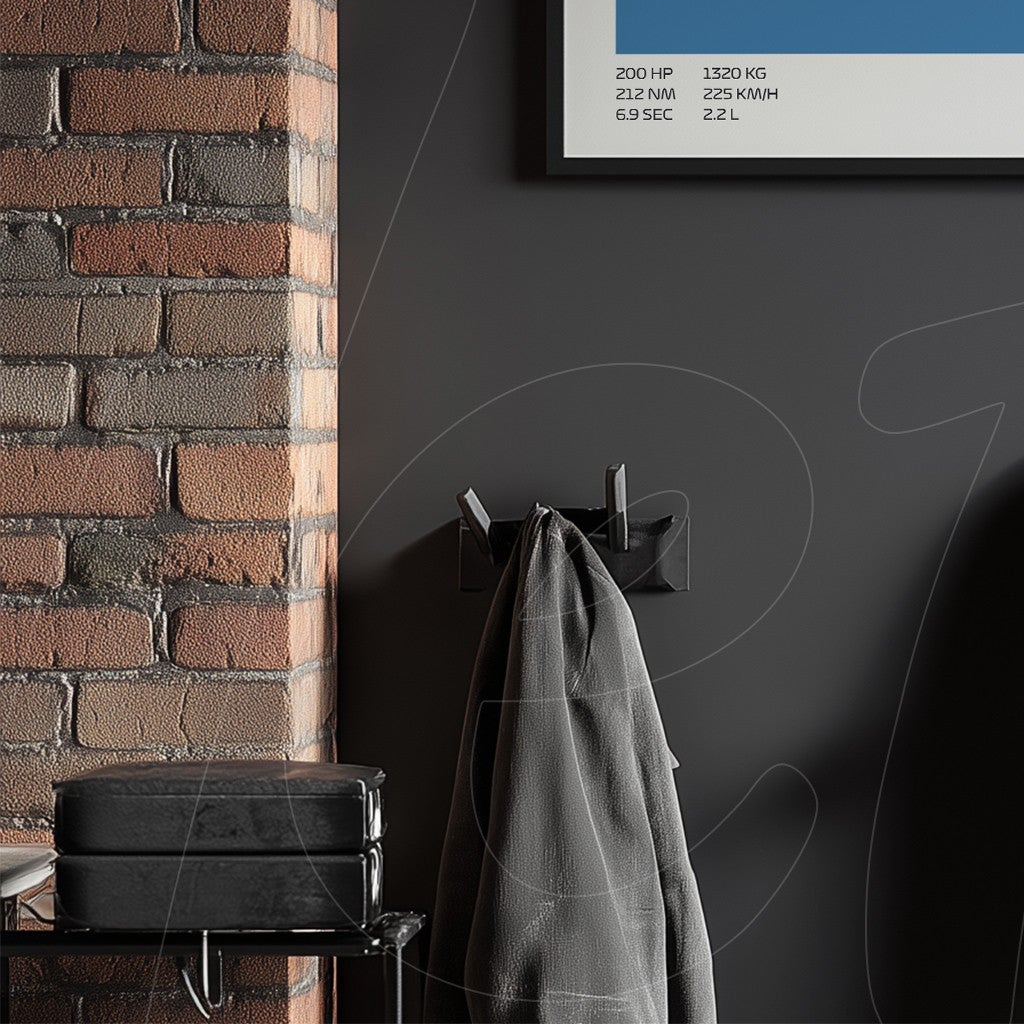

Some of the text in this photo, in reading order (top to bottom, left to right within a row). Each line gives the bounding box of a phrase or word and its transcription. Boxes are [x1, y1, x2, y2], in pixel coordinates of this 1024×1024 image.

[615, 67, 674, 80] 200 HP
[703, 67, 767, 80] 1320 KG
[615, 87, 676, 101] 212 NM
[703, 87, 778, 102] 225 KM/H
[615, 108, 673, 121] 6.9 SEC
[703, 108, 740, 121] 2.2 L
